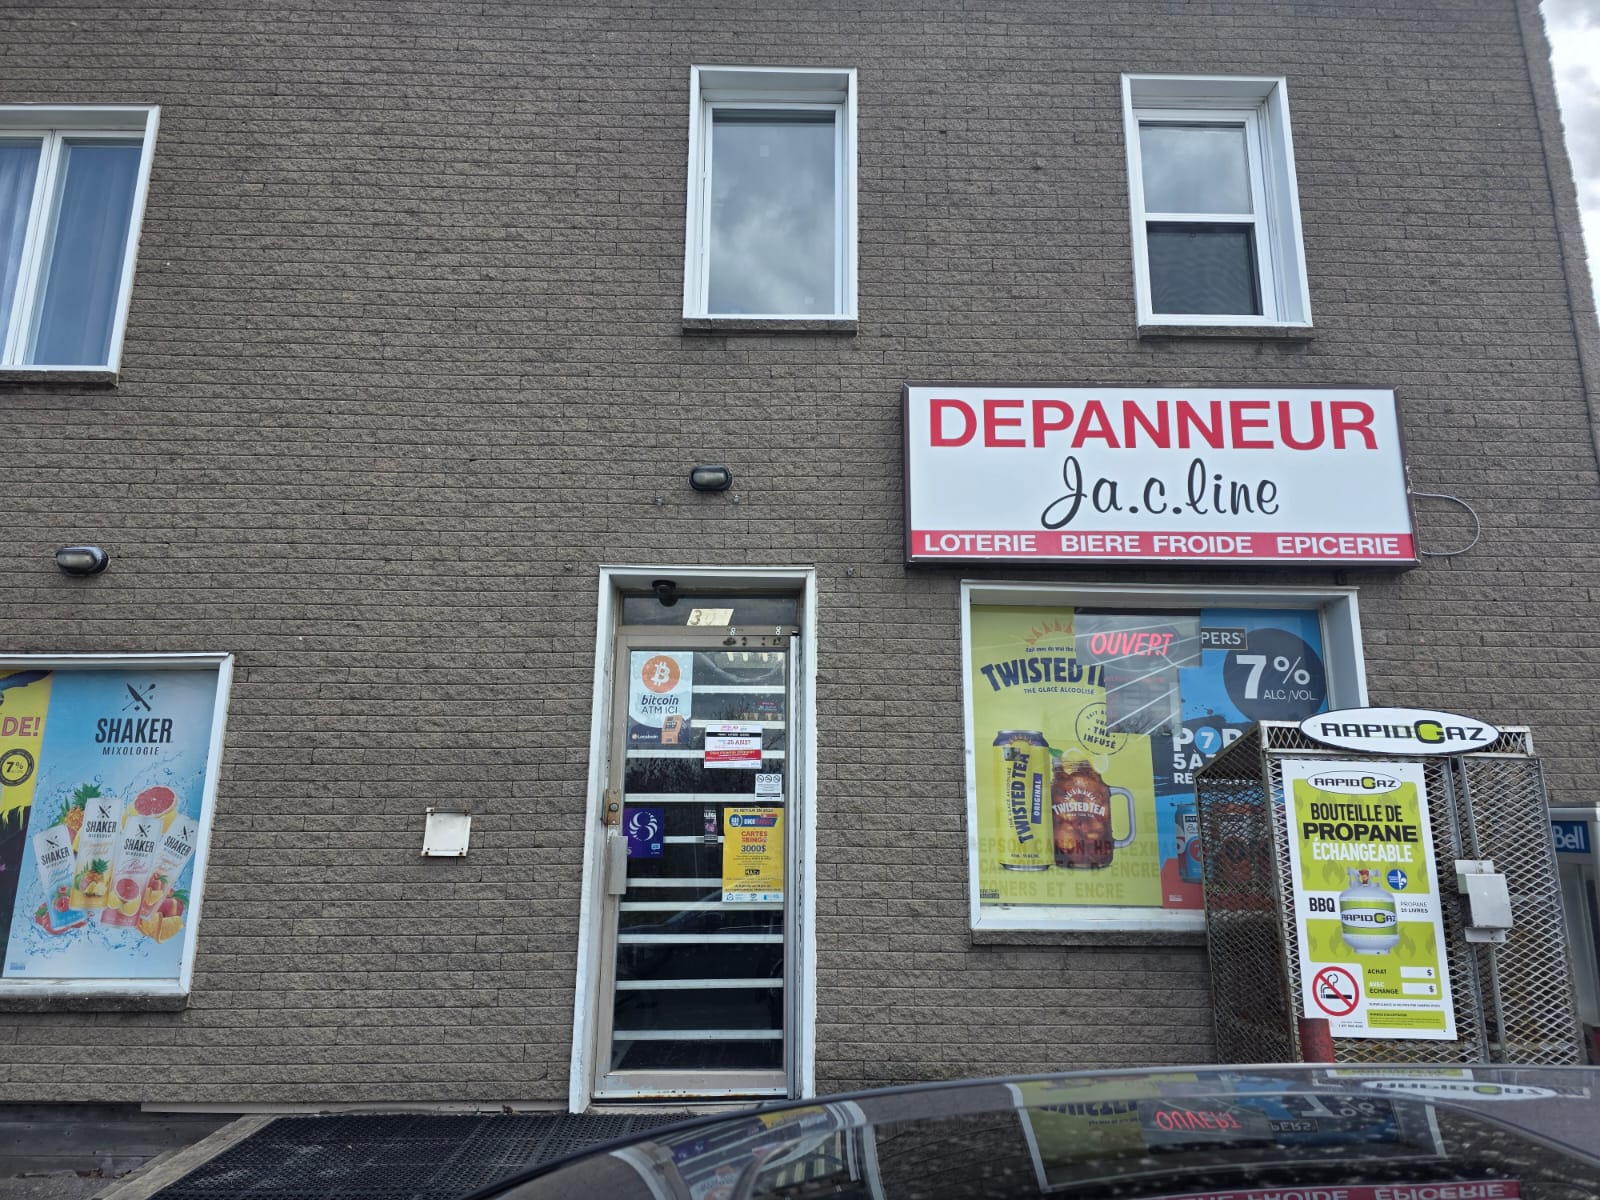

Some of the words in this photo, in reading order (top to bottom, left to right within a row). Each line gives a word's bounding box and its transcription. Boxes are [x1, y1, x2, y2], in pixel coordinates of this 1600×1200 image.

[930, 399, 1378, 450] DEPANNEUR
[924, 534, 1037, 552] LOTERIE
[1061, 535, 1141, 553] BIERE
[1153, 535, 1253, 553] FROIDE
[1277, 537, 1400, 555] EPICERIE
[1091, 632, 1174, 656] OUVERT
[981, 658, 1083, 692] TWISTED
[641, 695, 679, 706] bitcoin
[641, 706, 663, 714] ATM
[665, 706, 678, 714] ICI
[95, 718, 173, 744] SHAKER
[102, 746, 160, 755] MIXOLOGIE
[1033, 779, 1042, 816] ORIGINAL
[1011, 781, 1033, 844] TWISTED
[1052, 801, 1089, 816] TWISTED
[1089, 802, 1105, 817] TEA
[1311, 803, 1383, 822] BOUTEILLE
[1385, 805, 1403, 822] DE
[86, 820, 117, 832] SHAKER
[1303, 822, 1418, 842] PROPANE
[124, 838, 154, 853] SHAKER
[164, 836, 191, 856] SHAKER
[1553, 825, 1585, 849] Bell
[41, 846, 70, 866] SHAKER
[1312, 838, 1413, 862] ÉCHANGEABLE
[1309, 897, 1335, 912] BBQ
